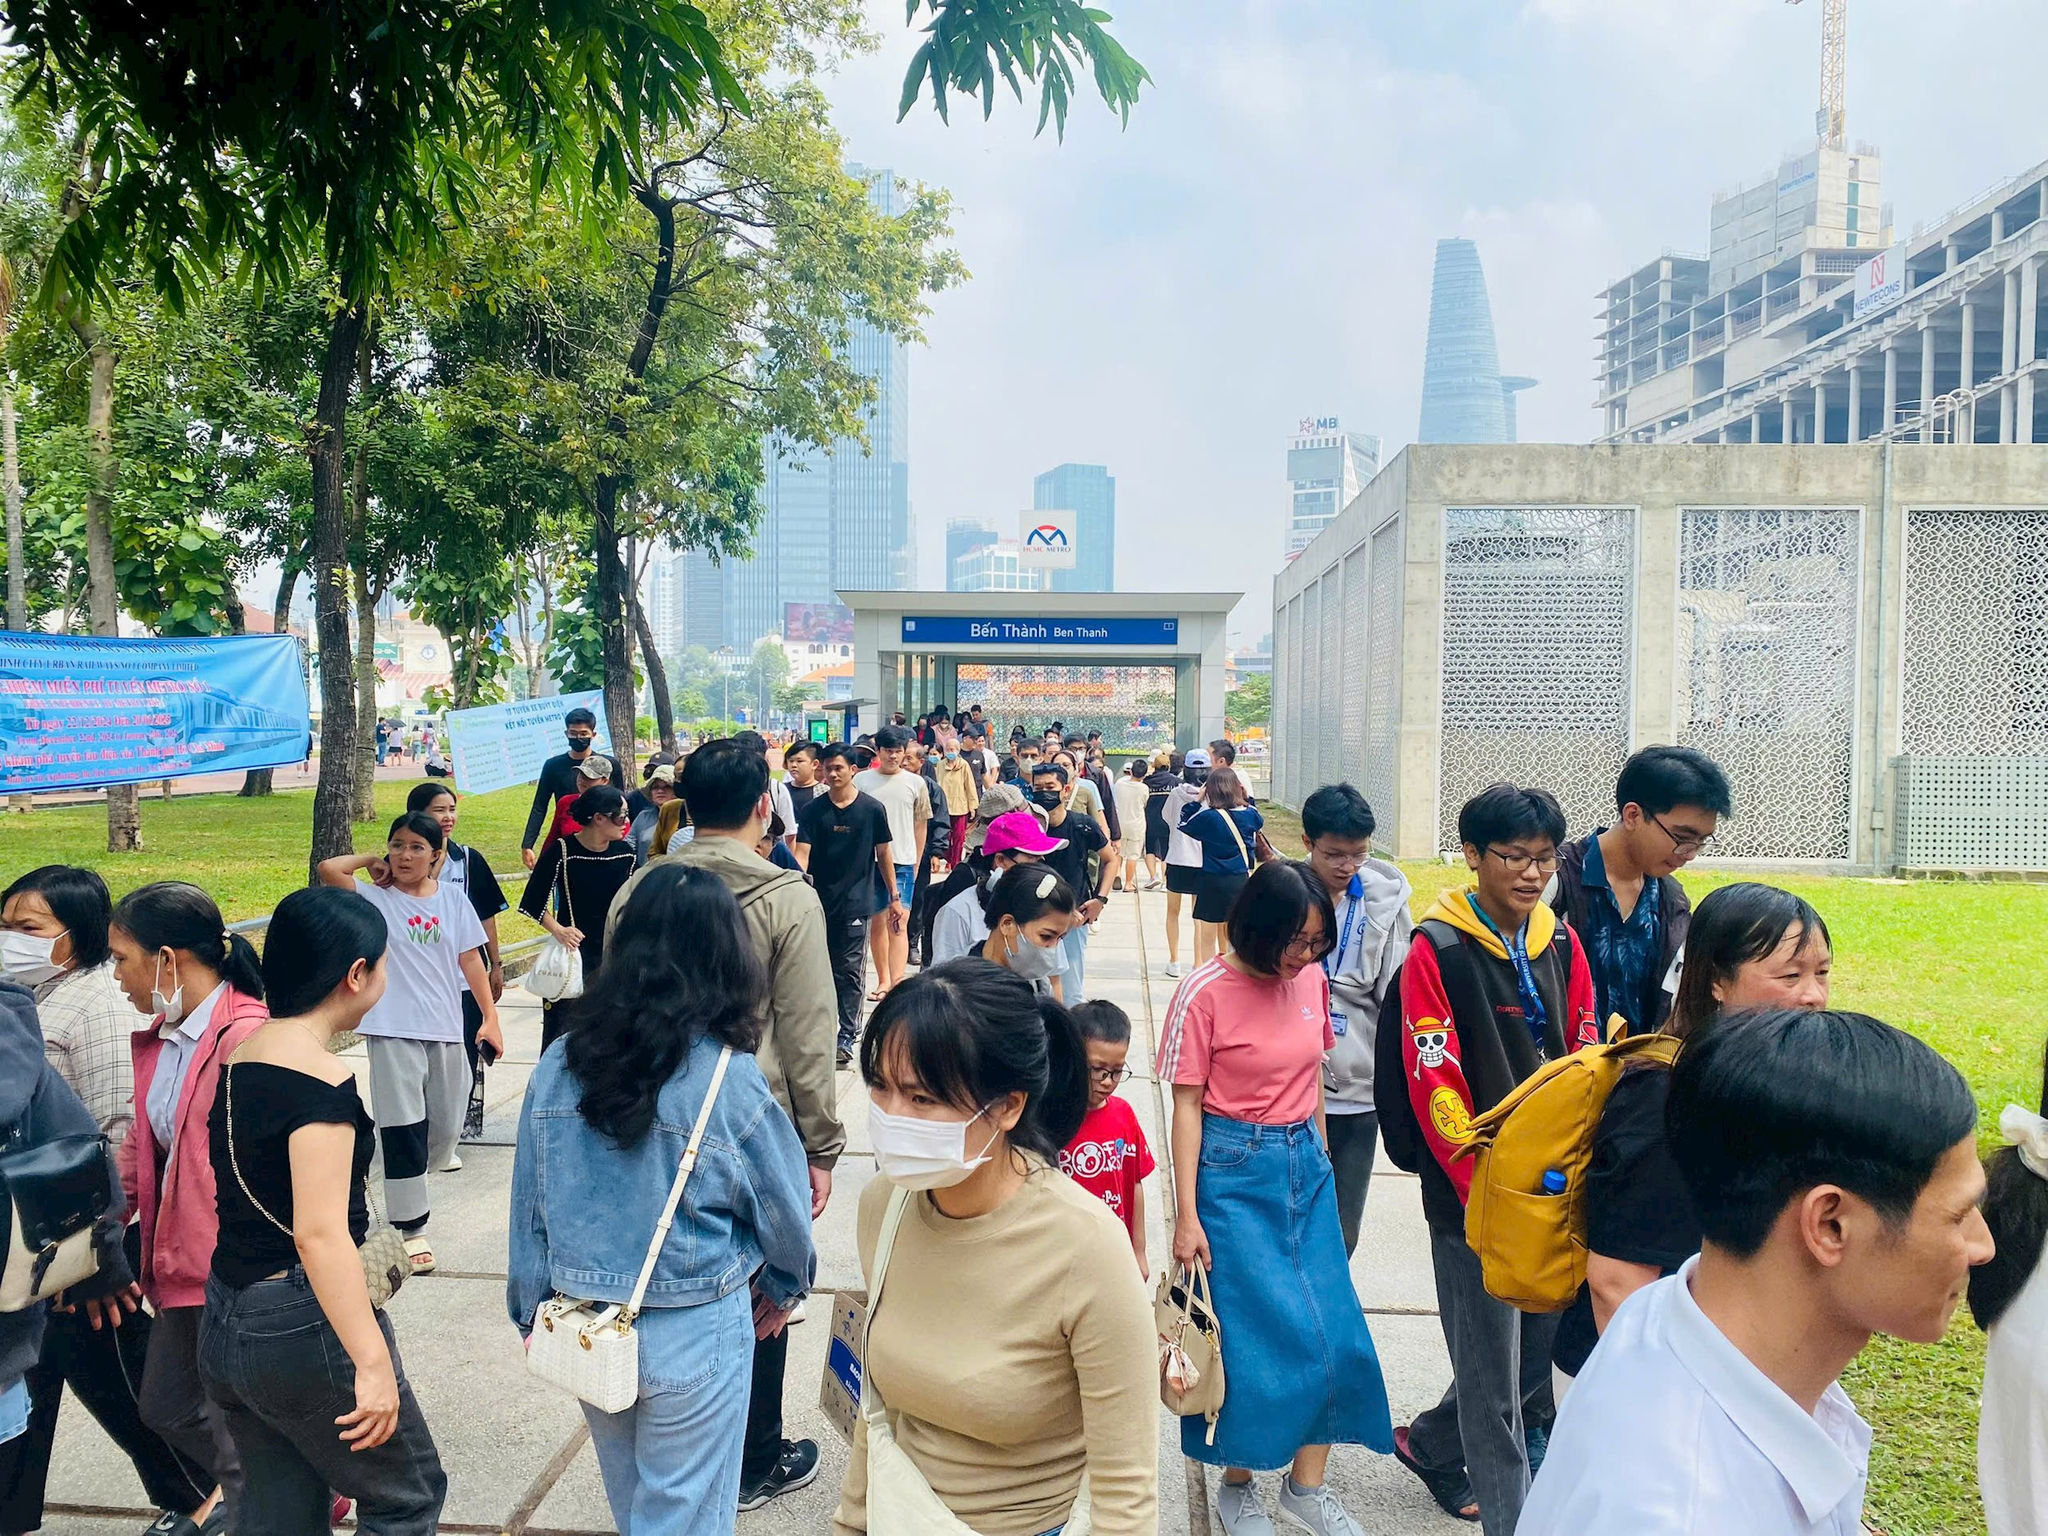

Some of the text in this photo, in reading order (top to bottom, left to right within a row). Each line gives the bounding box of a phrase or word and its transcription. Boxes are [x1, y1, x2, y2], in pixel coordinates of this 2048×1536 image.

[1855, 280, 1900, 311] NEWTECONS
[1316, 417, 1338, 430] MB
[970, 621, 1108, 638] Bến Thành Ben Thanh
[83, 676, 104, 693] PHÍ
[1521, 959, 1534, 989] UNIVERSITY
